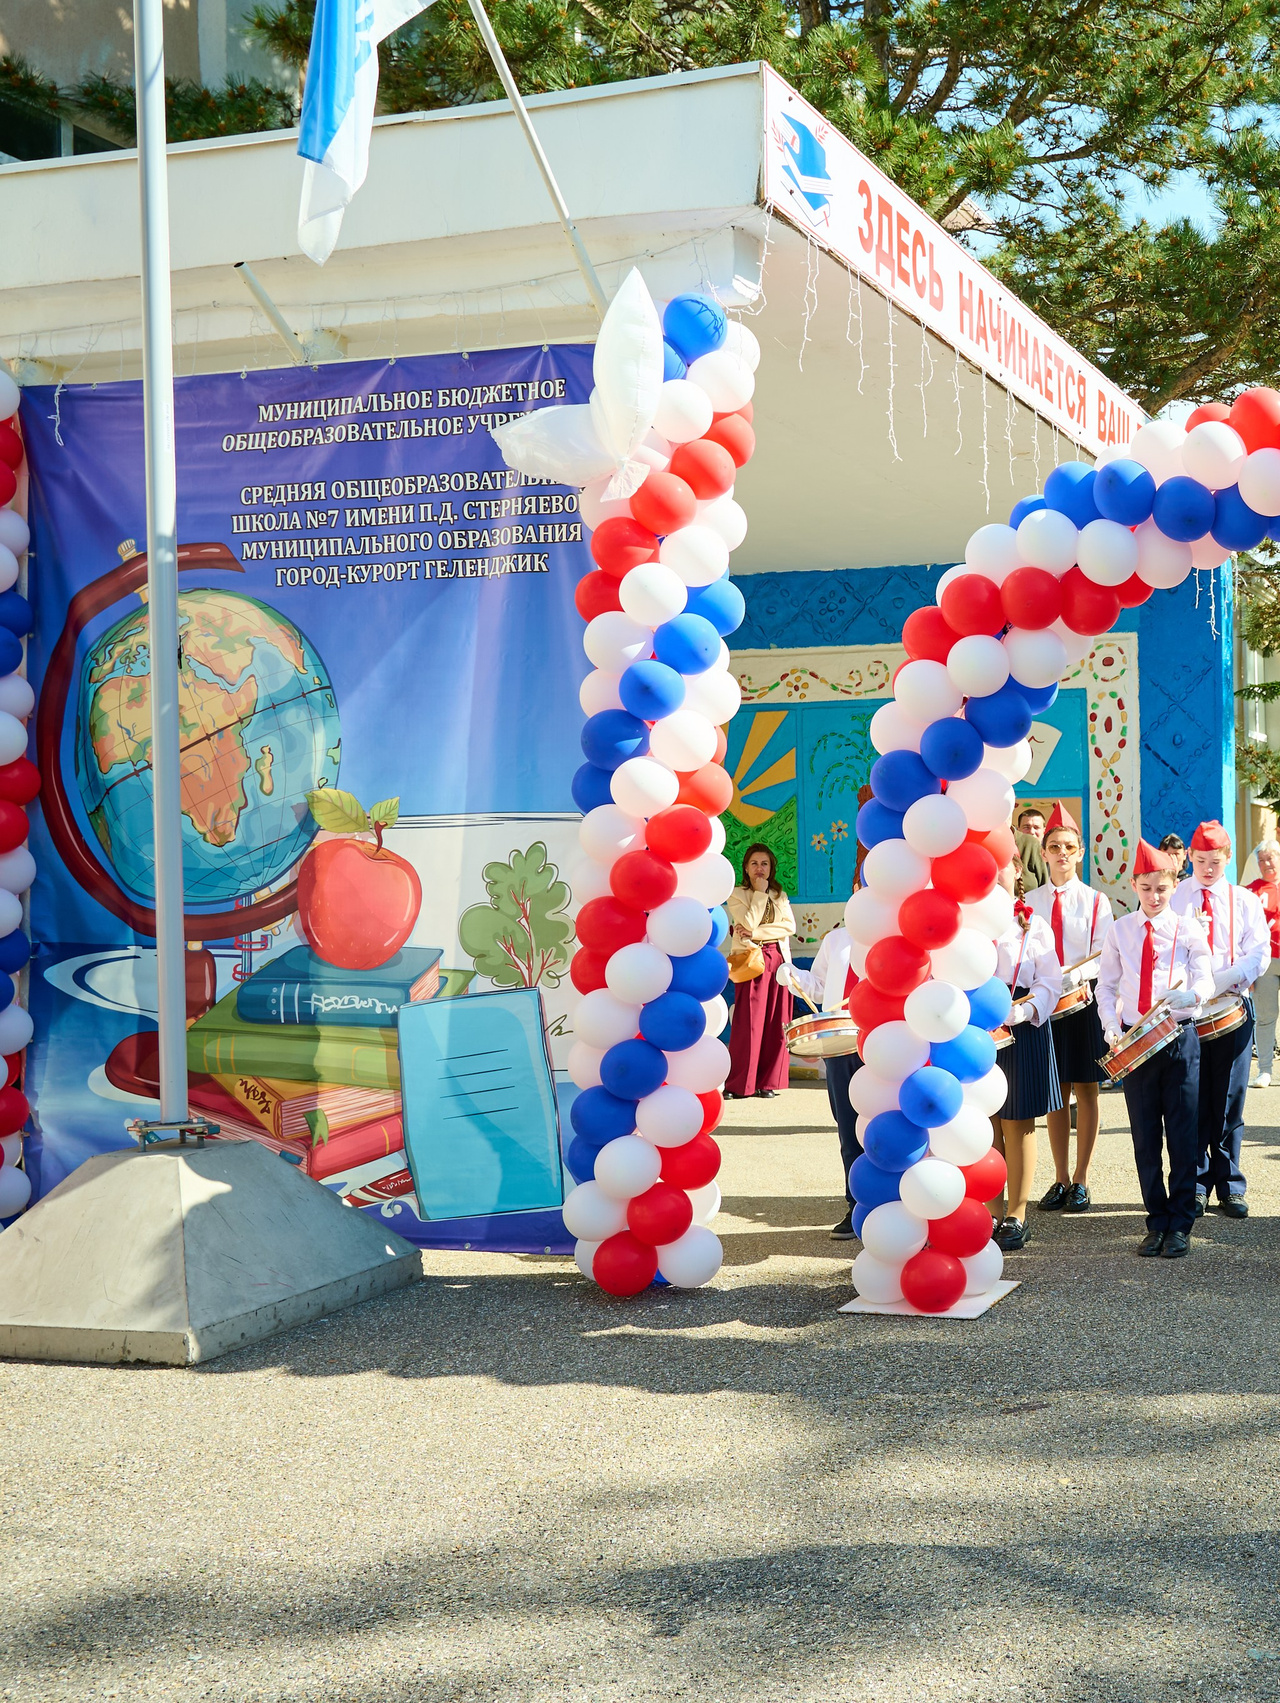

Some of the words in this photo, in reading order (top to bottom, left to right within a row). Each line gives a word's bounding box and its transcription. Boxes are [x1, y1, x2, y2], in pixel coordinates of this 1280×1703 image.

[858, 179, 944, 312] ЗДЕСЬ
[959, 270, 1087, 429] НАЧИНАЕТСЯ
[1097, 389, 1130, 447] ВАШ
[258, 389, 433, 424] МУНИЦИПАЛЬНОЕ
[437, 378, 567, 410] БЮДЖЕТНОЕ
[221, 416, 464, 454] ОБЩЕОБРАЗОВАТЕЛЬНОЕ
[231, 511, 303, 534] ШКОЛА
[306, 508, 340, 529] №7
[344, 503, 415, 528] ИМЕНИ
[419, 501, 459, 527] П.Д.
[463, 487, 586, 521] СТЕРНЯЕВО
[240, 481, 327, 507] СРЕДНЯЯ
[241, 530, 434, 562] МУНИЦИПАЛЬНОГО
[437, 522, 583, 551] ОБРАЗОВАНИЯ
[275, 560, 420, 589] ГОРОД-КУРОРТ
[424, 553, 549, 580] ГЕЛЕНДЖИК
